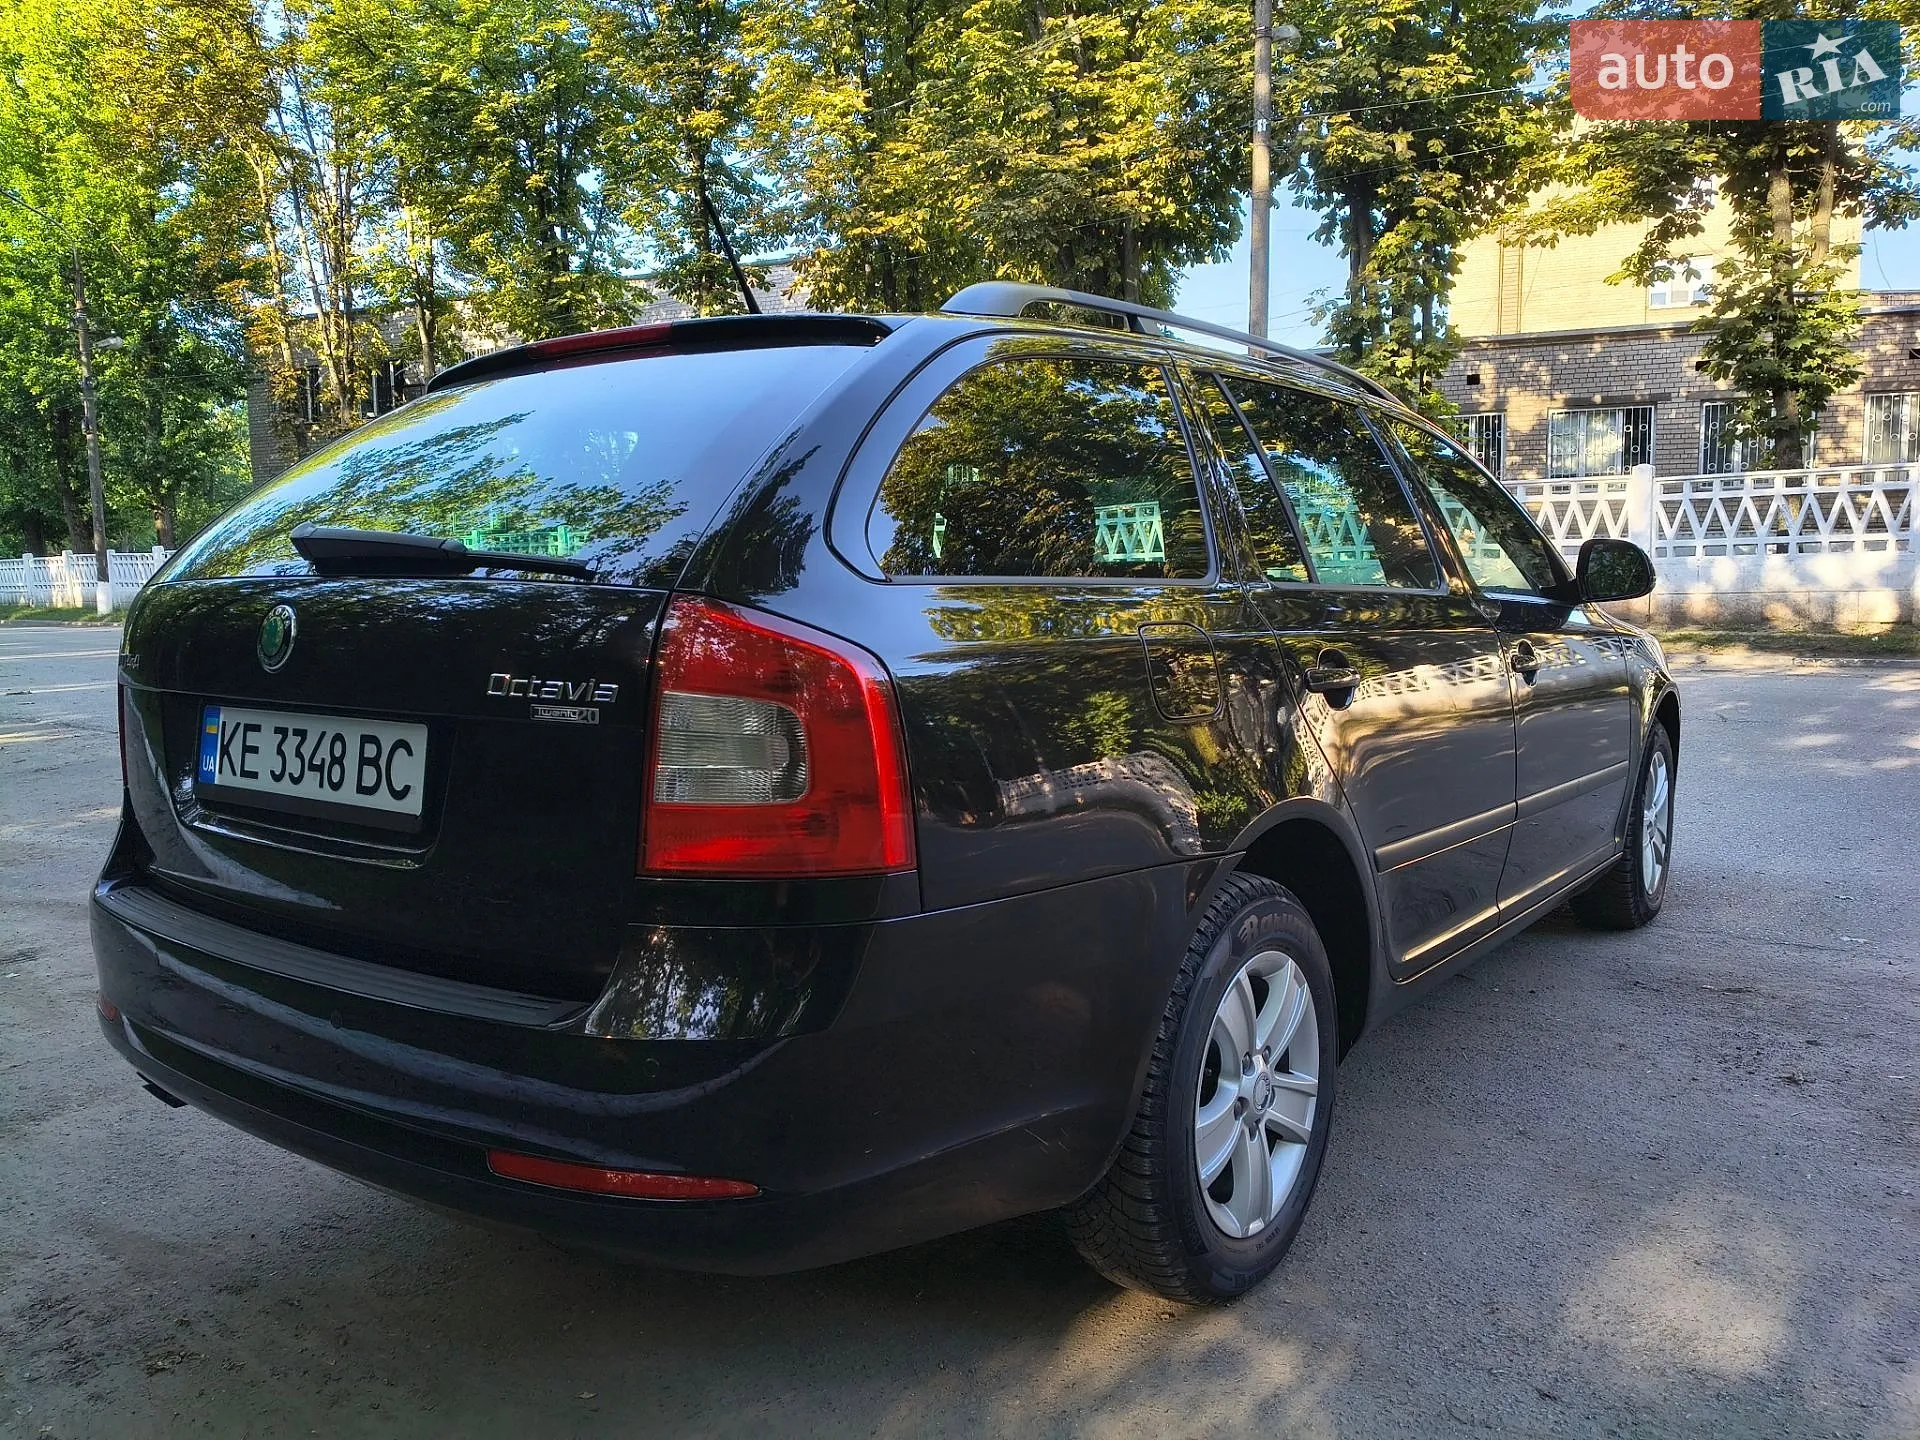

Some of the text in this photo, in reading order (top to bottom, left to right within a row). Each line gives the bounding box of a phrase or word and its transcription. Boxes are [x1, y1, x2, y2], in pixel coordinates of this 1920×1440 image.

[486, 673, 619, 703] Octavia
[202, 754, 215, 773] UA
[218, 720, 414, 801] KE 3348 BC
